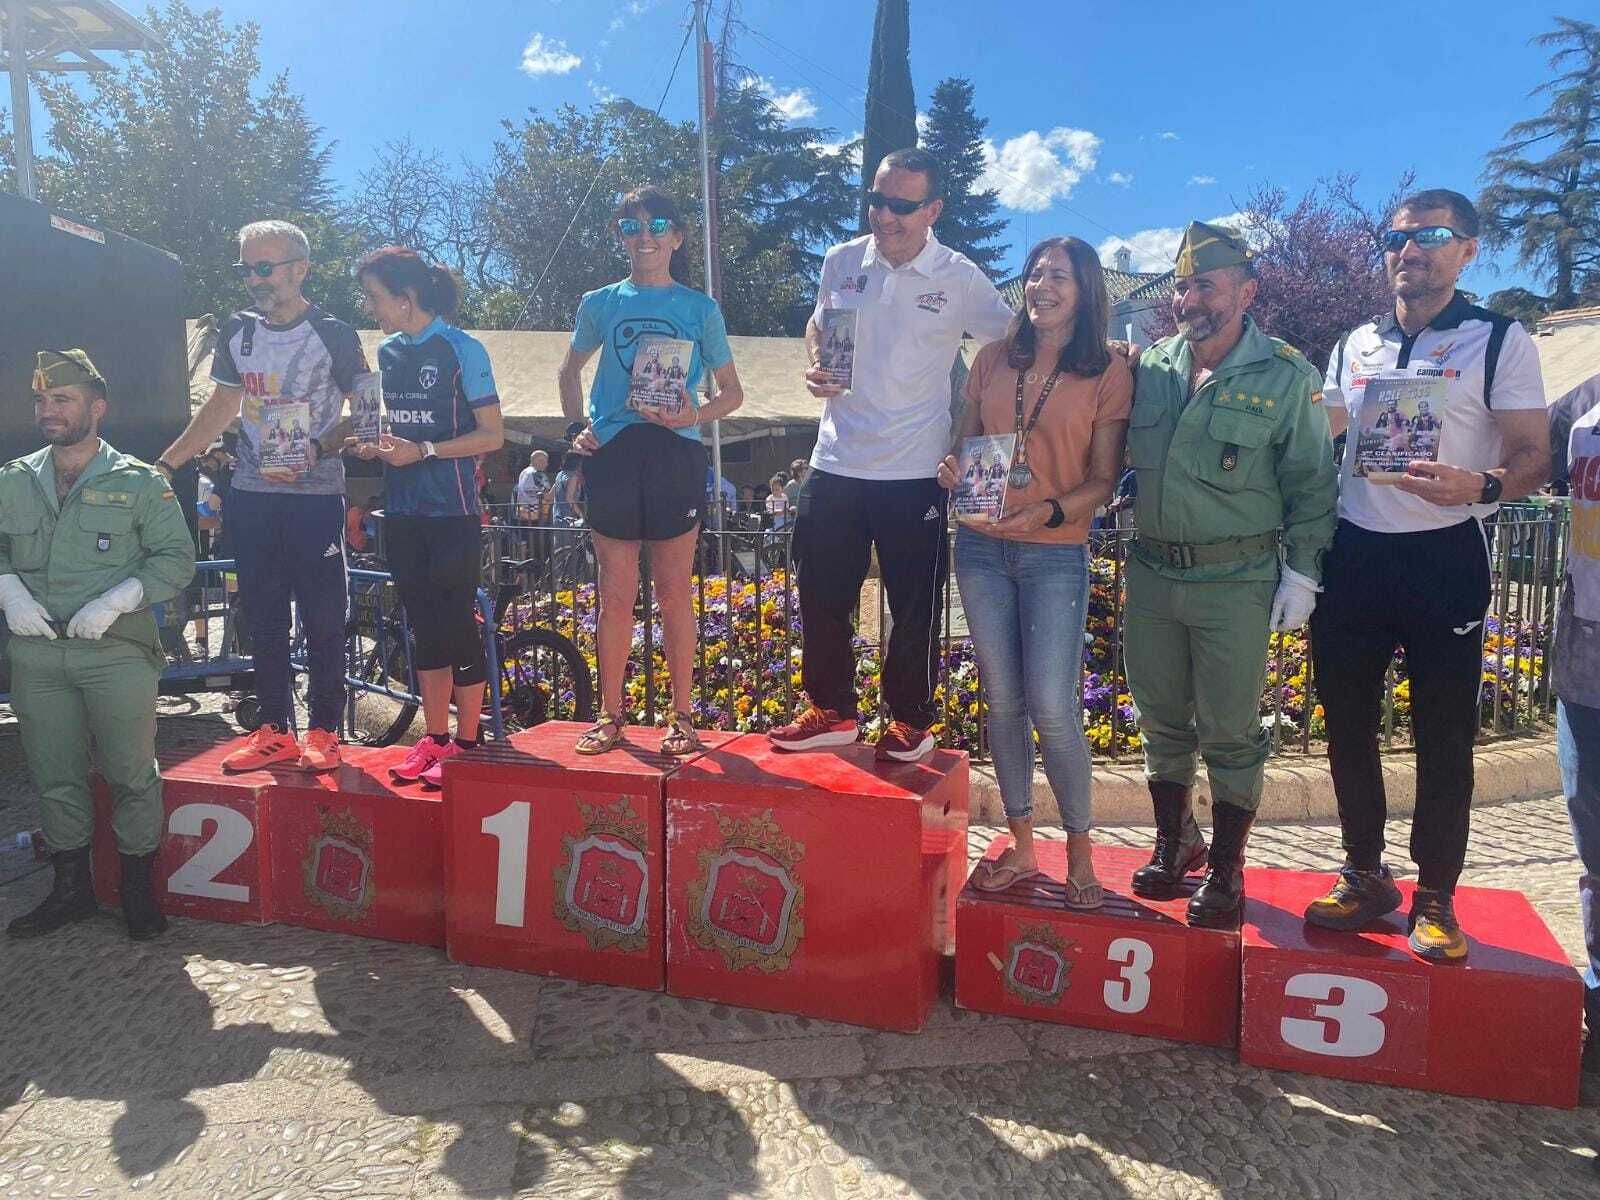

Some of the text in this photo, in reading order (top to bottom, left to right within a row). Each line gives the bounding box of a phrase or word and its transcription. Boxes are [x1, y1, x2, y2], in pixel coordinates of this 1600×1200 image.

[167, 803, 254, 903] 2
[481, 800, 531, 928] 1
[1103, 937, 1154, 1013] 3
[1280, 973, 1389, 1057] 3
